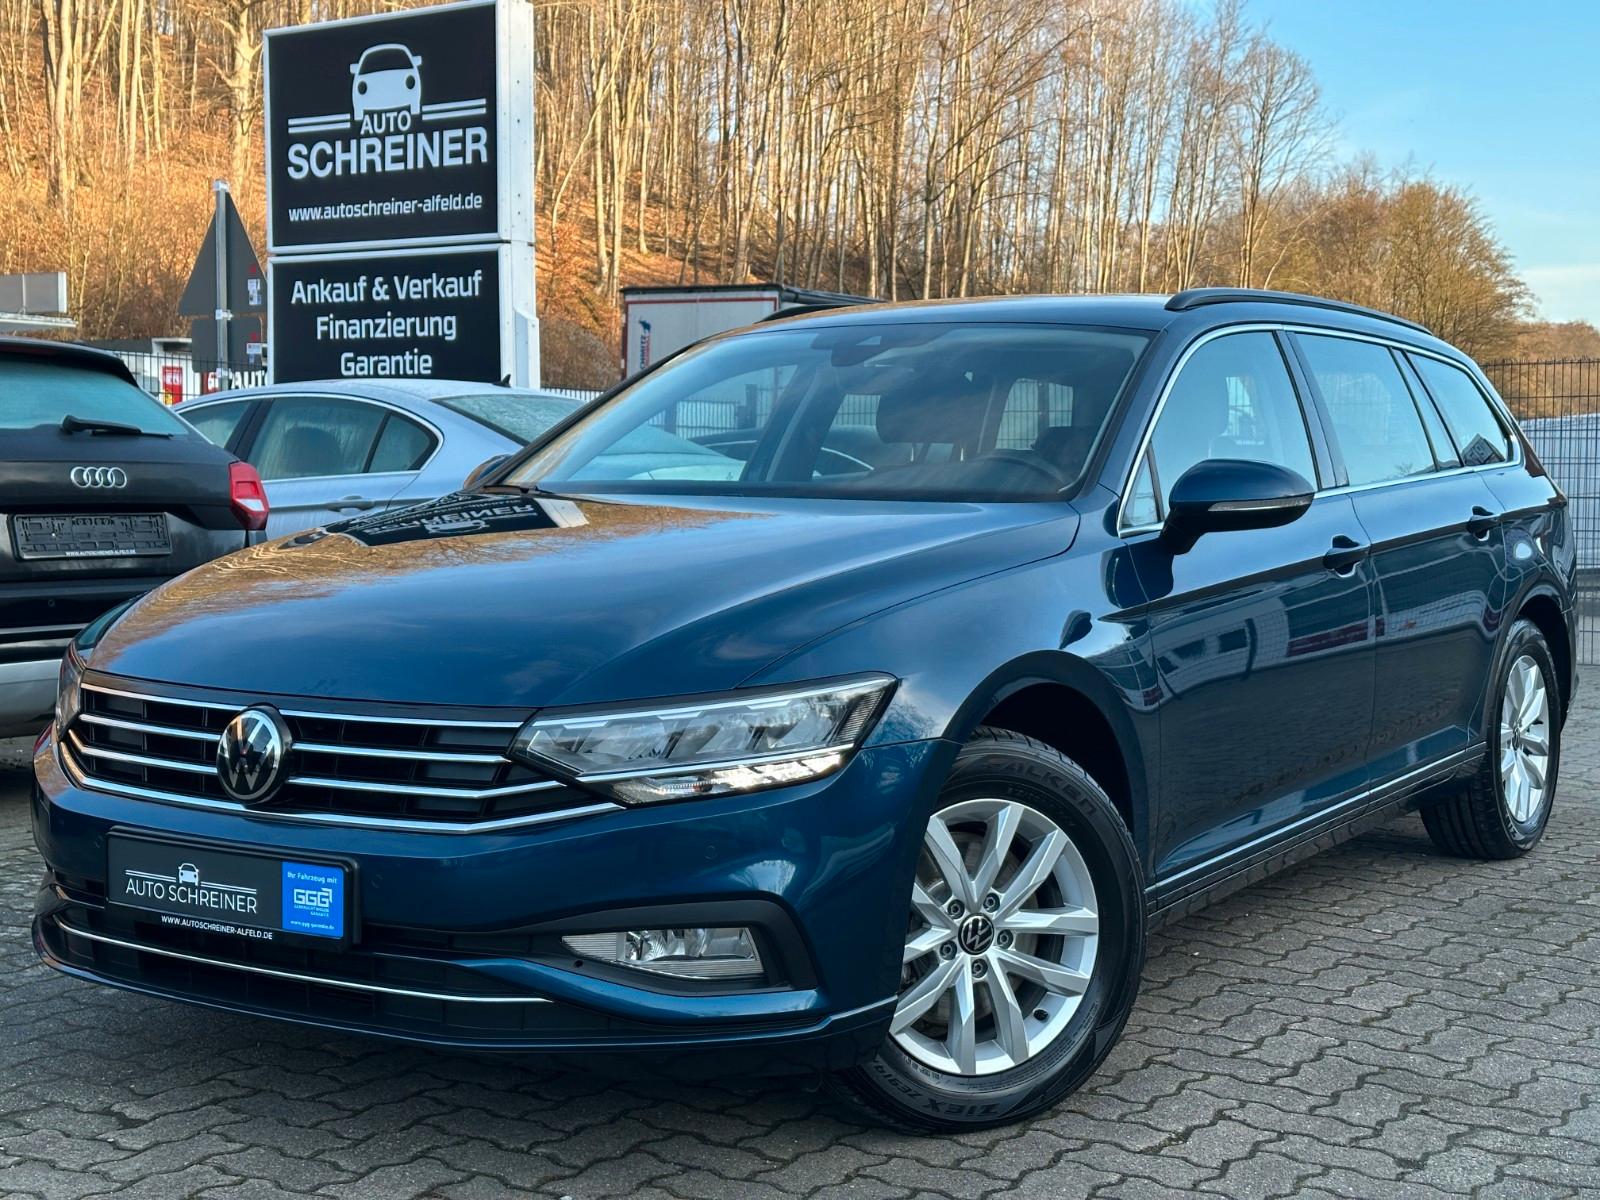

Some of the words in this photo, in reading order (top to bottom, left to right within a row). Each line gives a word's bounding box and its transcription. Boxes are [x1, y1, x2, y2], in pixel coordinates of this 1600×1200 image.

[360, 110, 412, 136] AUTO
[287, 127, 488, 180] SCHREINER
[288, 192, 483, 222] www.autoschreiner-alfeld.de
[291, 275, 368, 305] Ankauf
[371, 276, 390, 301] &
[393, 269, 483, 299] Verkauf
[316, 311, 457, 341] Finanzierung
[340, 348, 433, 376] Garantie
[297, 872, 326, 884] Fahrzeug
[125, 877, 165, 900] AUTO
[168, 885, 258, 914] SCHREINER
[161, 914, 273, 941] WWW.AUTOSCHREINER-ALFELD.DE
